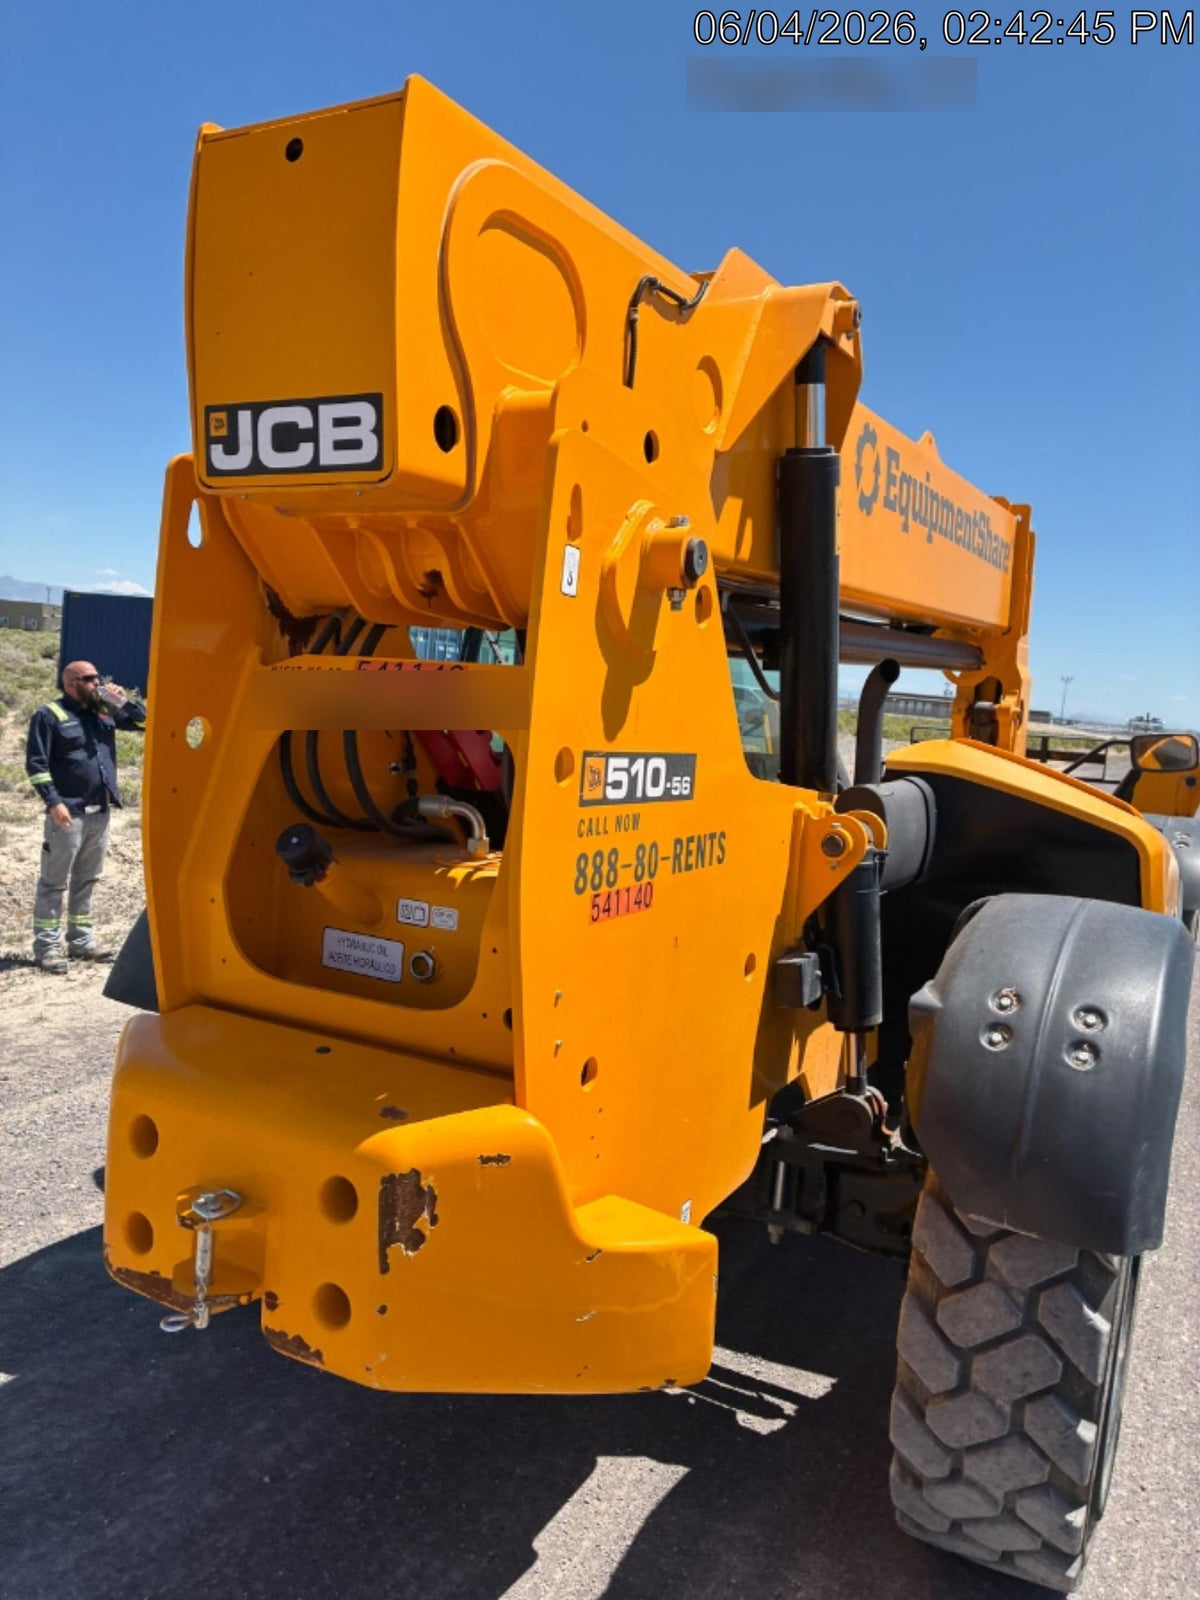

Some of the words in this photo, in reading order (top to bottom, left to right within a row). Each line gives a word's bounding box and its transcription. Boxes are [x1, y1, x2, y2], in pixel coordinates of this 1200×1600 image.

[210, 401, 379, 470] JCB
[883, 446, 1011, 573] EquipmentShare
[577, 816, 609, 838] CALL
[614, 813, 641, 833] NOW
[574, 831, 726, 895] 888-80-RENTS
[591, 882, 654, 922] 541140
